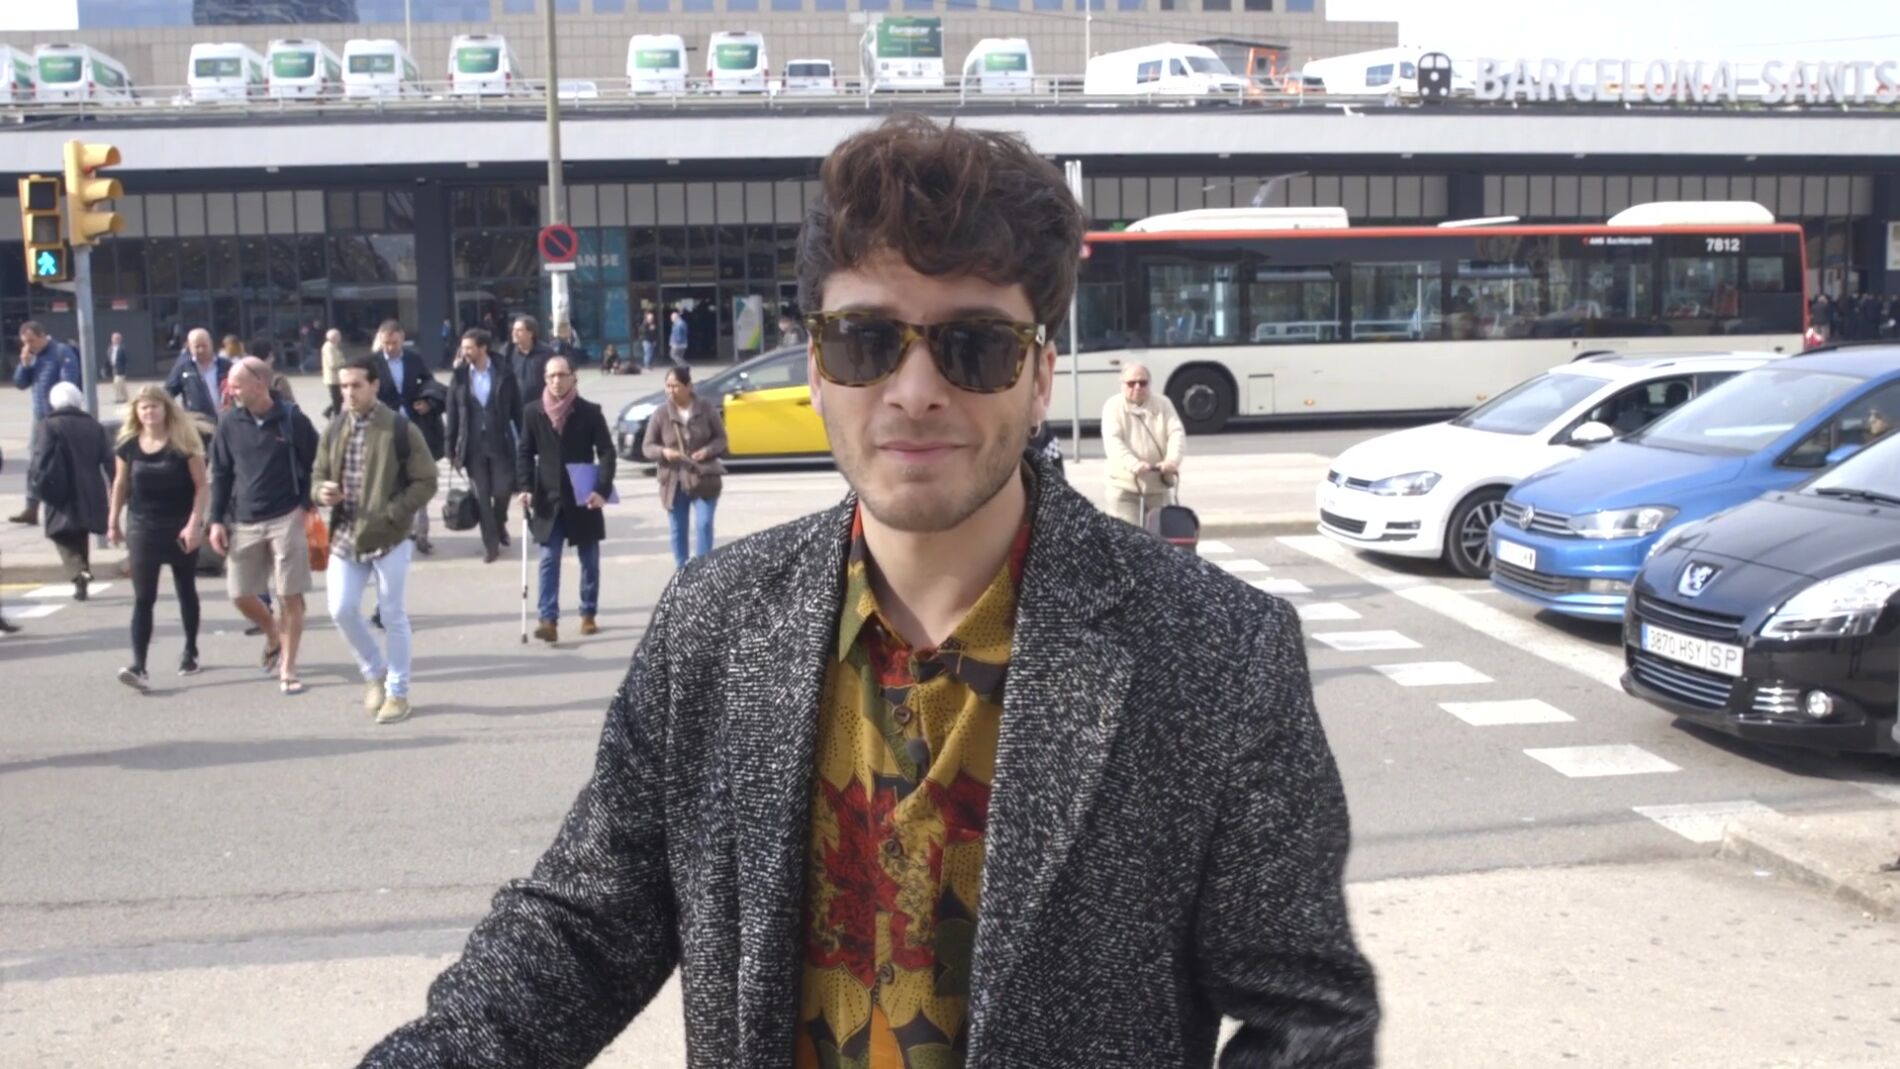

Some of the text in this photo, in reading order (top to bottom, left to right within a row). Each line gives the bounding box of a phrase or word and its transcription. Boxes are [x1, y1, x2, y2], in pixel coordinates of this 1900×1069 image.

[1705, 237, 1740, 252] 7812
[1650, 629, 1737, 670] 3870 HSY SP
